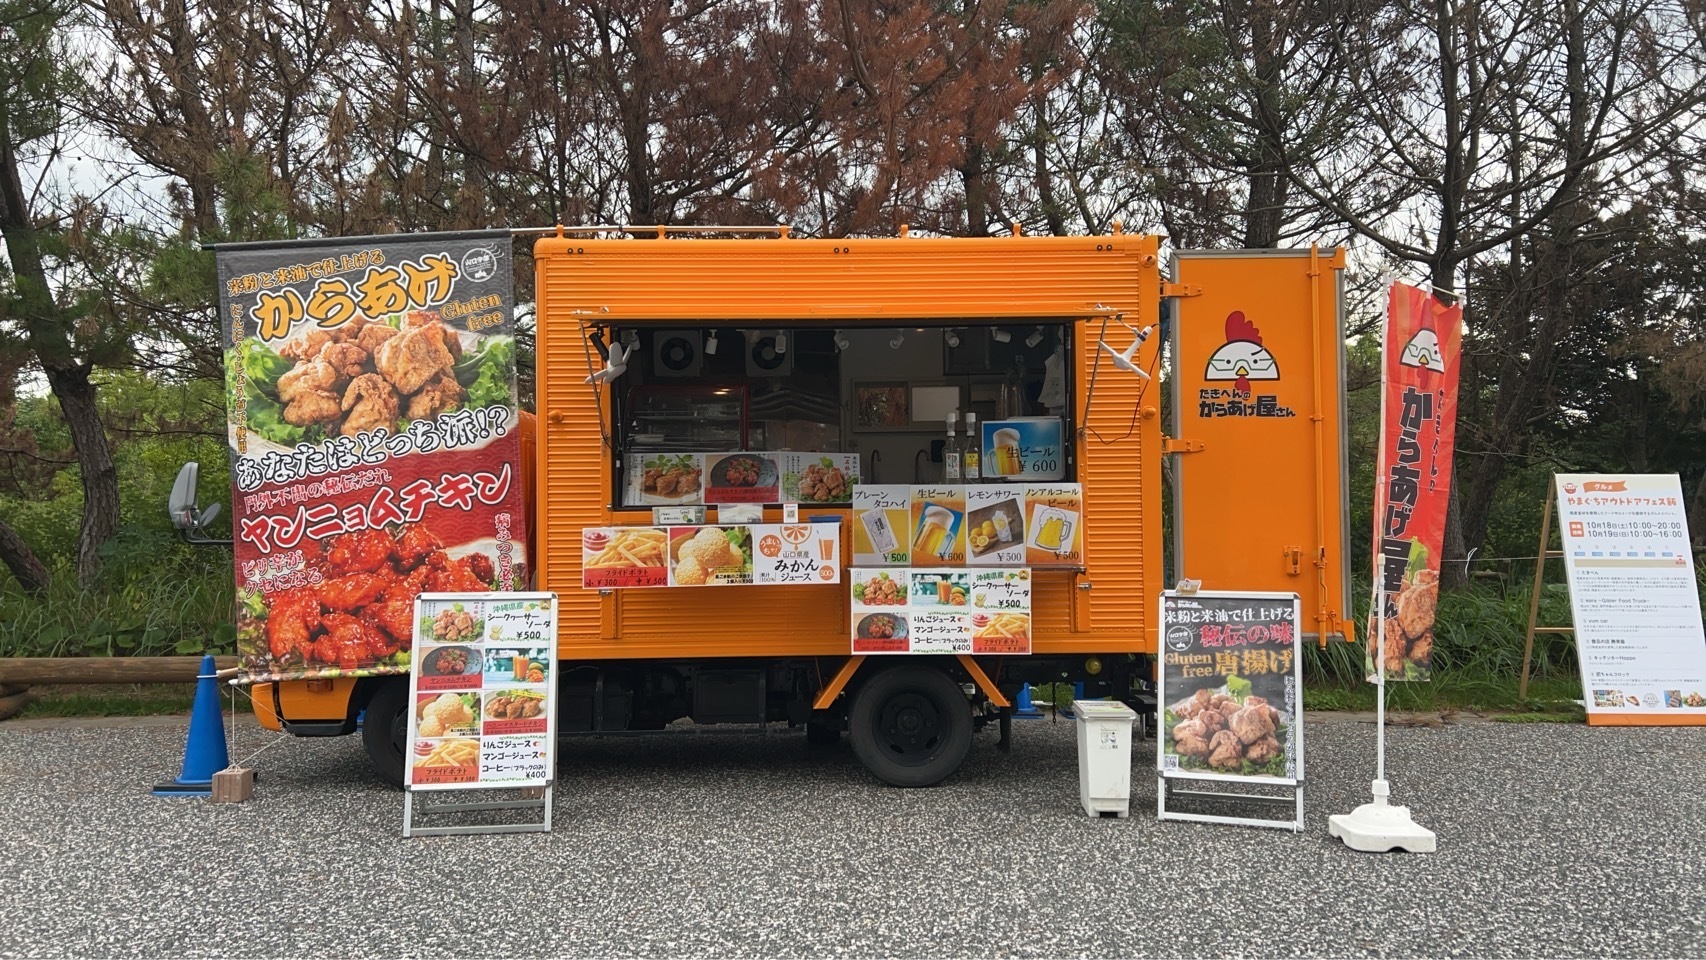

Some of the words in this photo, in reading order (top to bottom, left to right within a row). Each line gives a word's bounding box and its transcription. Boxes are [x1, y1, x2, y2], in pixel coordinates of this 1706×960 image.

[228, 249, 386, 297] 米粉と米油で仕上げる
[251, 252, 460, 342] からあげ
[441, 293, 502, 321] Gluten
[465, 311, 504, 332] free
[1199, 395, 1296, 418] からあげ屋さん
[1006, 445, 1056, 459] 生ビール
[243, 467, 392, 515] 門外不出の秘伝だれ
[1594, 482, 1613, 491] グルメ
[855, 491, 889, 500] プレーン
[917, 489, 957, 499] 生ビール
[968, 490, 1021, 500] レモンサワー
[1025, 487, 1080, 498] ノンアルコール
[873, 499, 906, 509] タコハイ
[1049, 499, 1078, 508] ビール
[1567, 496, 1677, 507] やまぐちアウトドアフェス飯
[240, 462, 511, 554] ヤンニョムチキン
[783, 551, 810, 560] 山口県産
[241, 549, 304, 579] ピリ辛が
[774, 558, 819, 573] みかん
[604, 568, 649, 577] フライドポテト
[781, 572, 812, 582] ジュース
[976, 571, 1005, 582] 沖縄県産
[243, 565, 323, 599] クセになる
[1006, 589, 1030, 598] ソーダ
[492, 601, 525, 613] 沖縄県産
[998, 599, 1021, 609] ¥500
[913, 615, 957, 624] りんごジュース
[1164, 607, 1294, 624] 米粉と米油で仕上げる
[526, 619, 551, 629] ソーダ
[516, 630, 541, 640] ¥500
[914, 626, 964, 634] マンゴージュース
[1200, 621, 1294, 648] 秘伝の味
[952, 643, 971, 652] ¥400
[1165, 651, 1213, 666] Gluten
[1213, 648, 1294, 676] 唐揚げ
[1182, 663, 1214, 678] free
[482, 740, 532, 750] りんごジュース
[483, 751, 540, 761] マンゴージュース
[525, 770, 547, 780] ¥400
